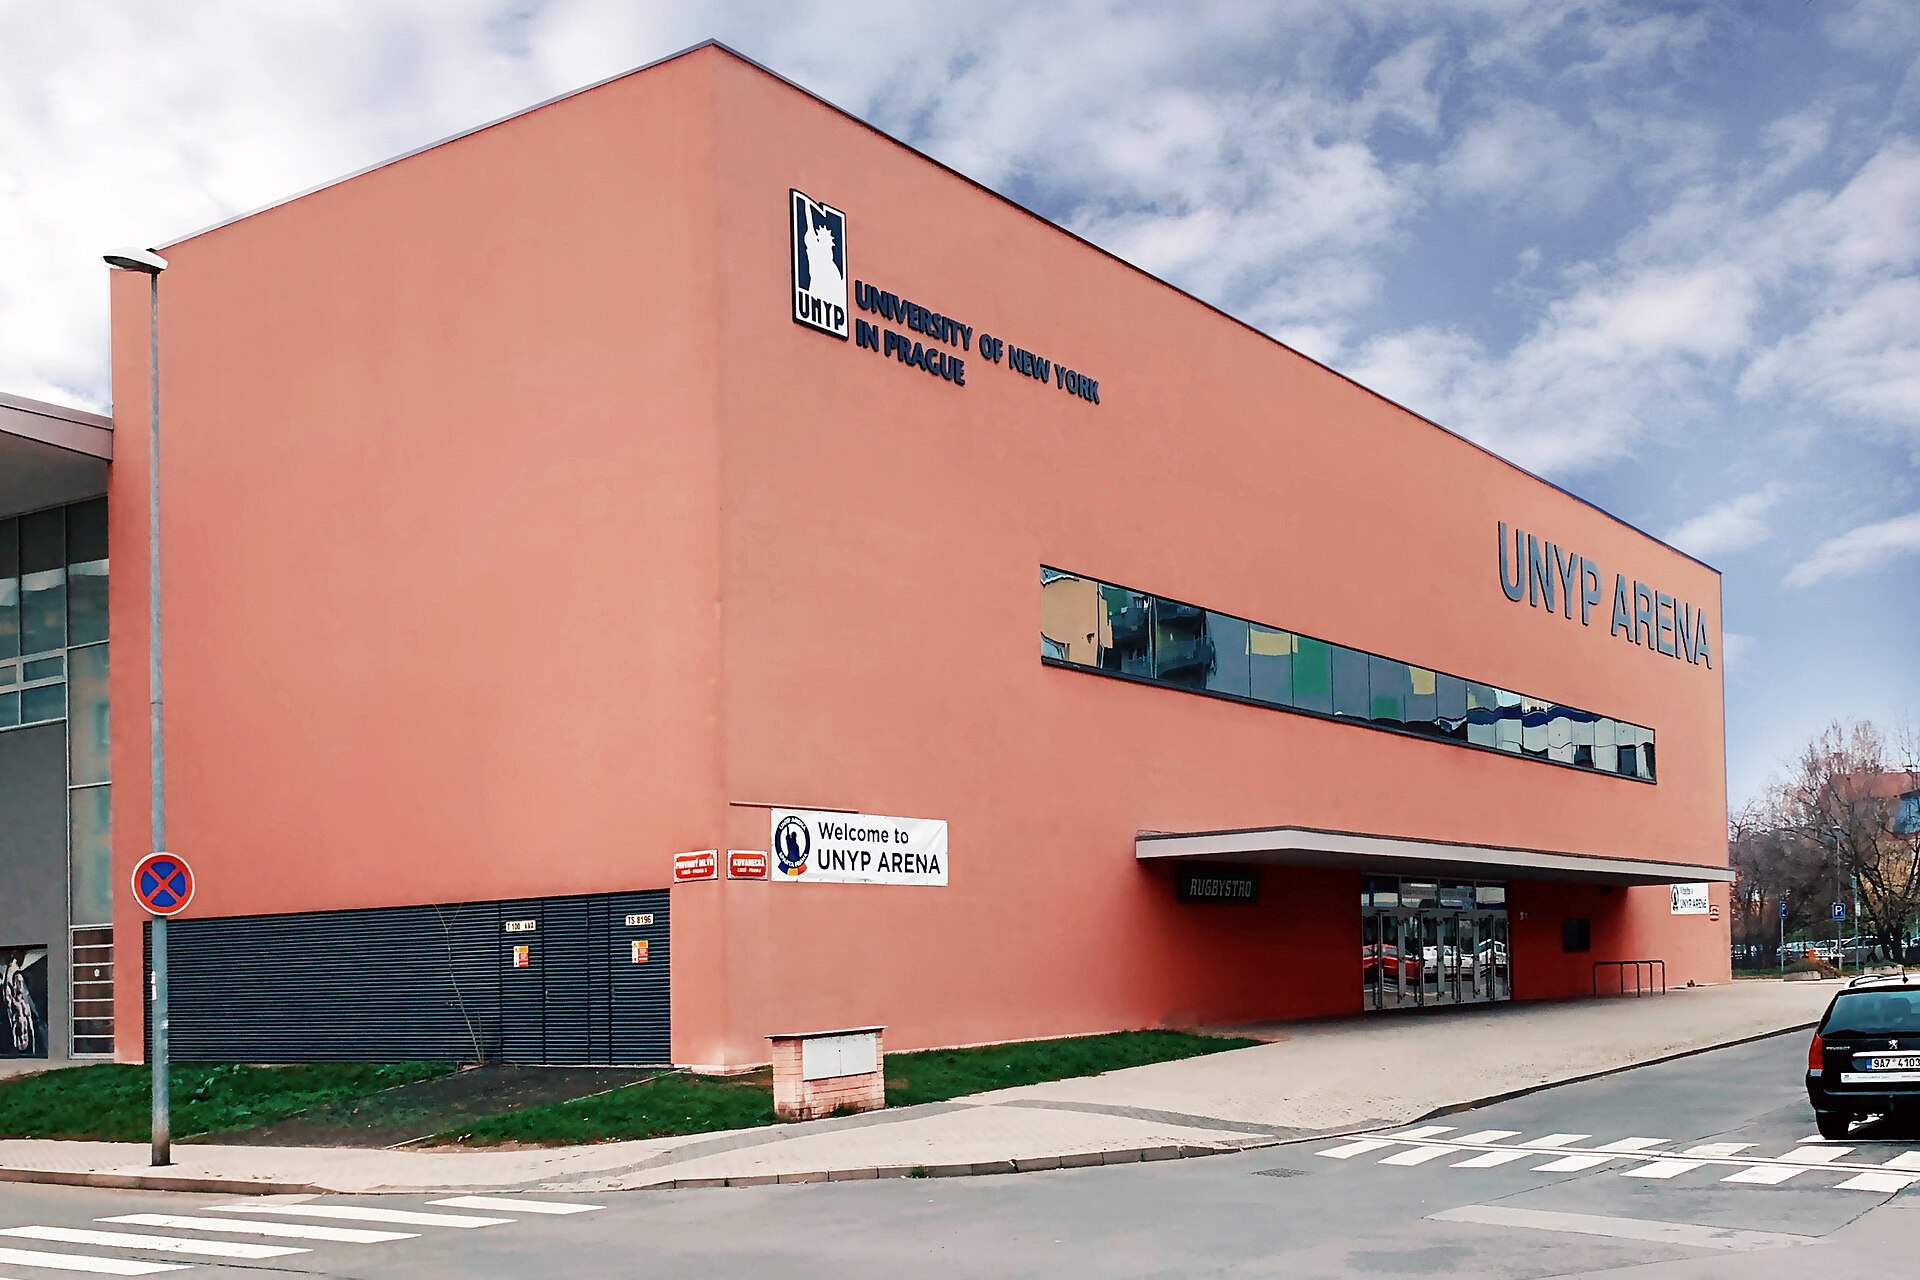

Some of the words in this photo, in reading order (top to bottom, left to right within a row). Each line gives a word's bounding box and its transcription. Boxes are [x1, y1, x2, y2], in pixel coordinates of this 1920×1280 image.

[799, 291, 844, 330] UNYP
[855, 280, 972, 351] UNIVERSITY
[979, 333, 1003, 364] OF
[1008, 344, 1050, 383] NEW
[1054, 363, 1100, 404] YORK
[855, 318, 879, 352] IN
[884, 329, 966, 386] PRAGUE
[1498, 521, 1602, 626] UNYP
[1611, 573, 1712, 669] ARENA
[818, 822, 889, 843] Welcome
[895, 828, 909, 844] to
[818, 849, 871, 871] UNYP
[877, 852, 941, 874] ARENA
[1190, 879, 1251, 897] RUGBYSTRO
[636, 915, 651, 924] 8196
[1835, 905, 1843, 916] P
[1873, 1059, 1891, 1068] 9A7
[1898, 1058, 1920, 1067] 4103
